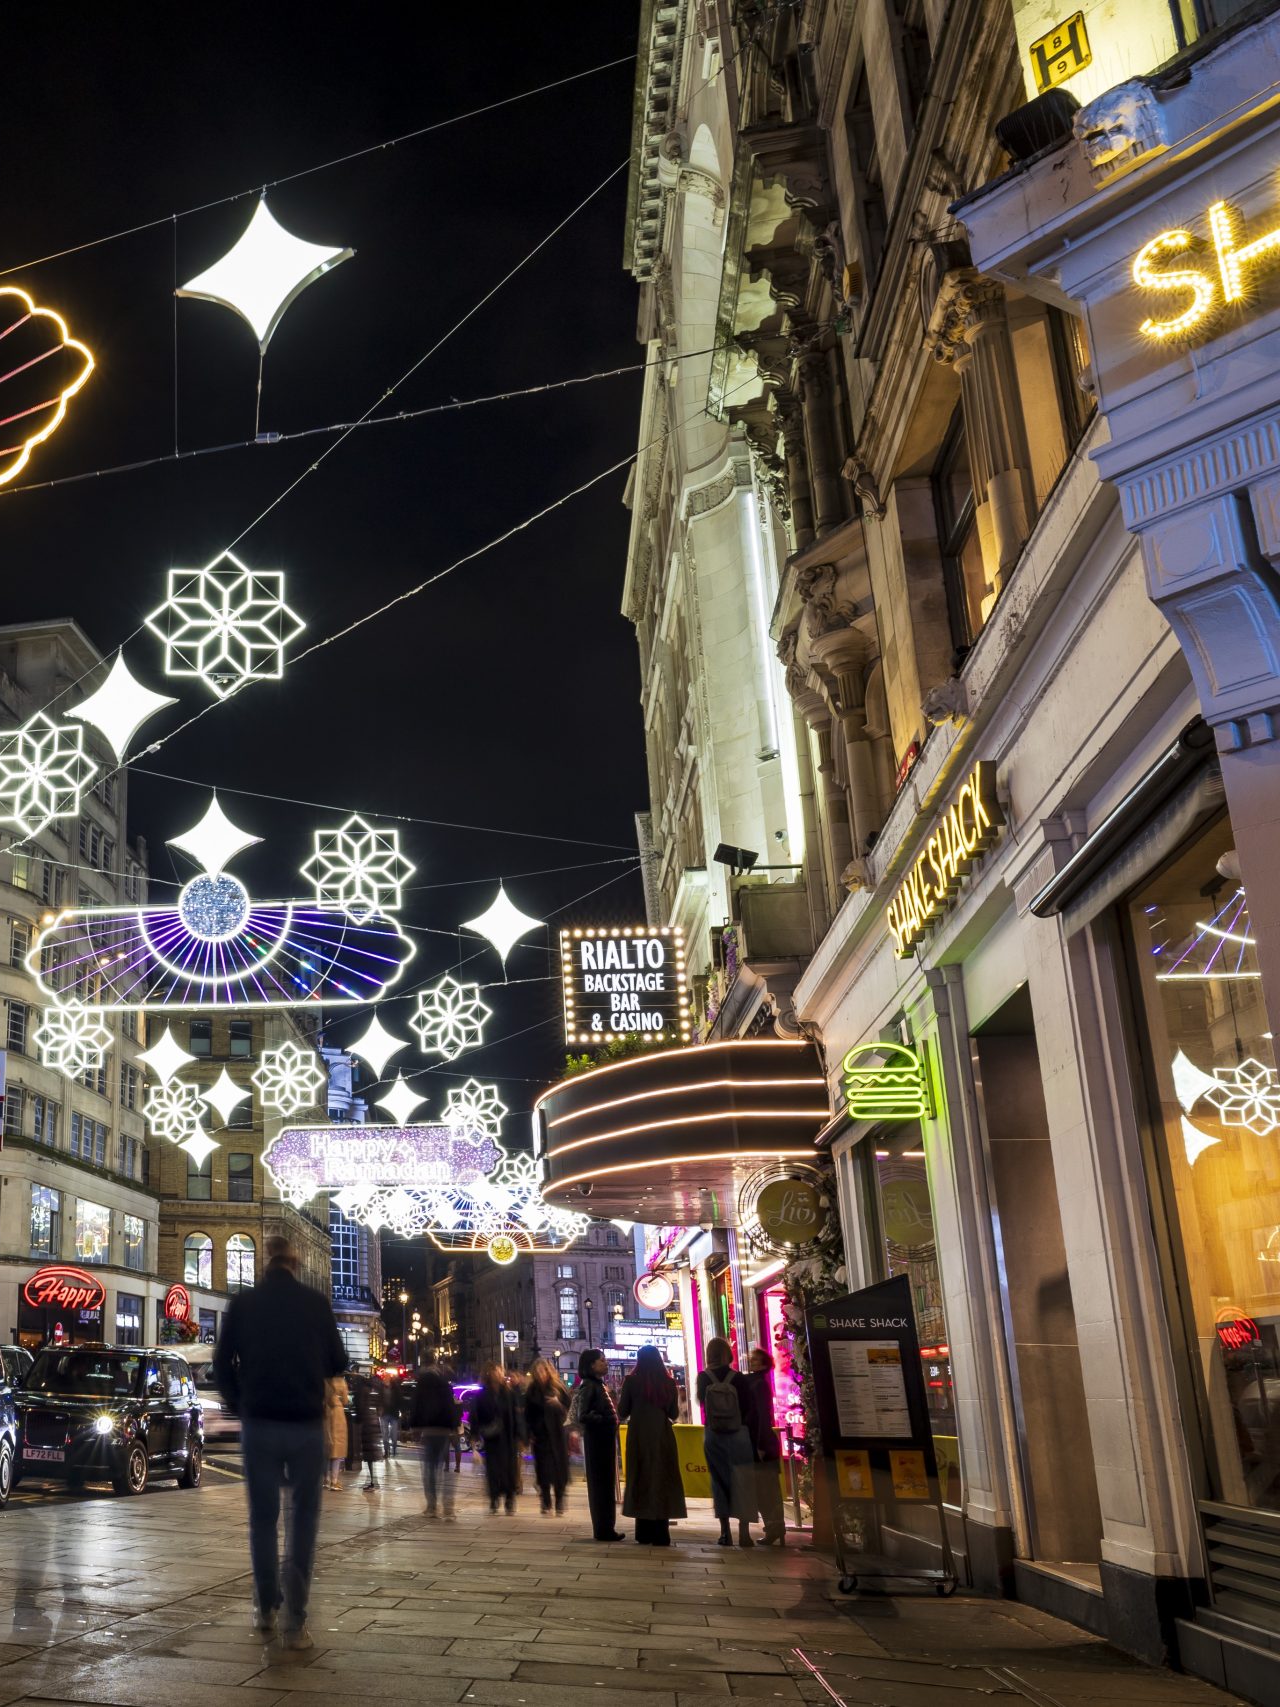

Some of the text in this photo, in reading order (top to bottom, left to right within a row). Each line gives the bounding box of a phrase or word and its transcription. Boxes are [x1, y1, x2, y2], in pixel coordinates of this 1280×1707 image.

[1053, 36, 1062, 49] 8
[1036, 21, 1085, 87] H
[1057, 61, 1067, 73] 9
[887, 760, 990, 960] SHAKE SHACK
[580, 939, 664, 970] RIALTO
[584, 972, 665, 992] BACKSTAGE
[610, 993, 640, 1011] BAR
[591, 1012, 664, 1031] & CASINO
[311, 1134, 397, 1162] Happy
[324, 1158, 451, 1182] Ramadan
[34, 1277, 97, 1309] Happy
[829, 1318, 908, 1328] SHAKE SHACK
[685, 1462, 707, 1473] Cas
